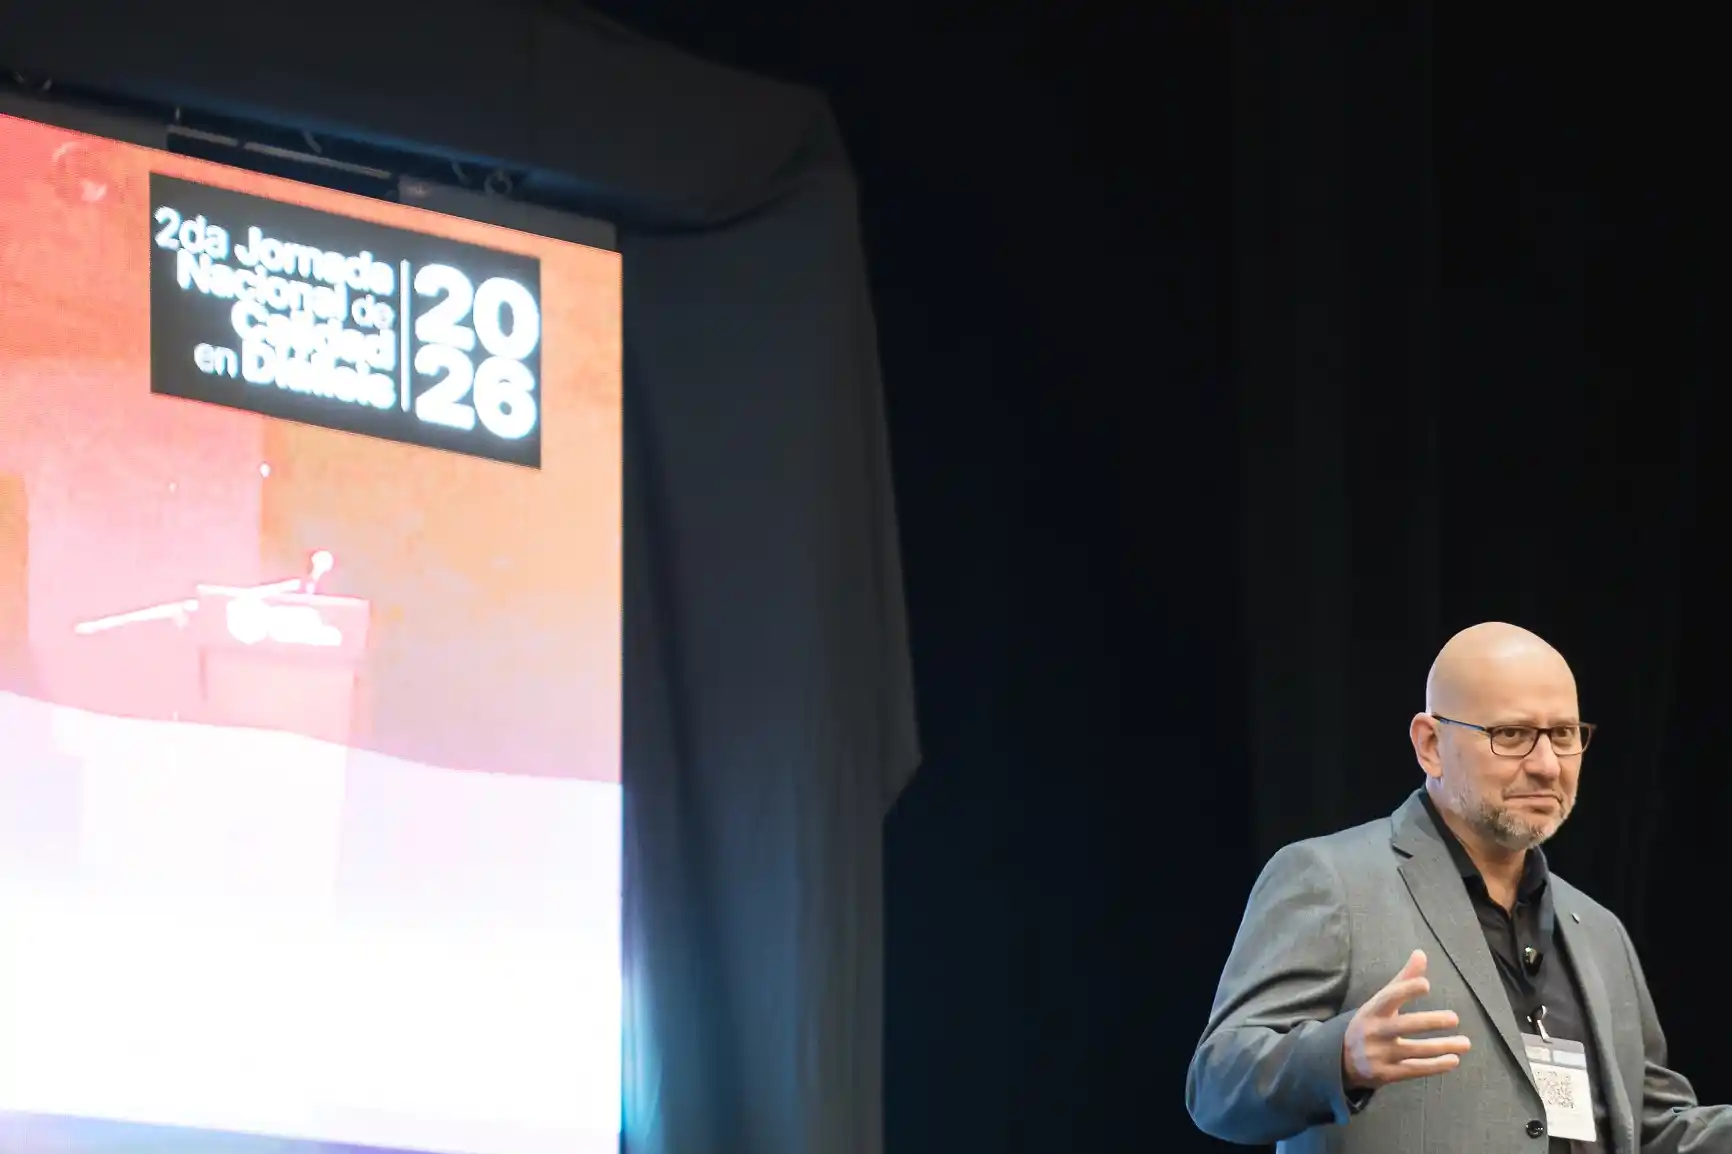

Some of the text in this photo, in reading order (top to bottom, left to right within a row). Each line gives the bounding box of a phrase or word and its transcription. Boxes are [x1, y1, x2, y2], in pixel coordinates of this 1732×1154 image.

[154, 206, 394, 296] 2da Jornada
[176, 248, 394, 330] Nacional de
[414, 263, 540, 360] 20
[194, 343, 238, 378] en
[414, 343, 538, 439] 26
